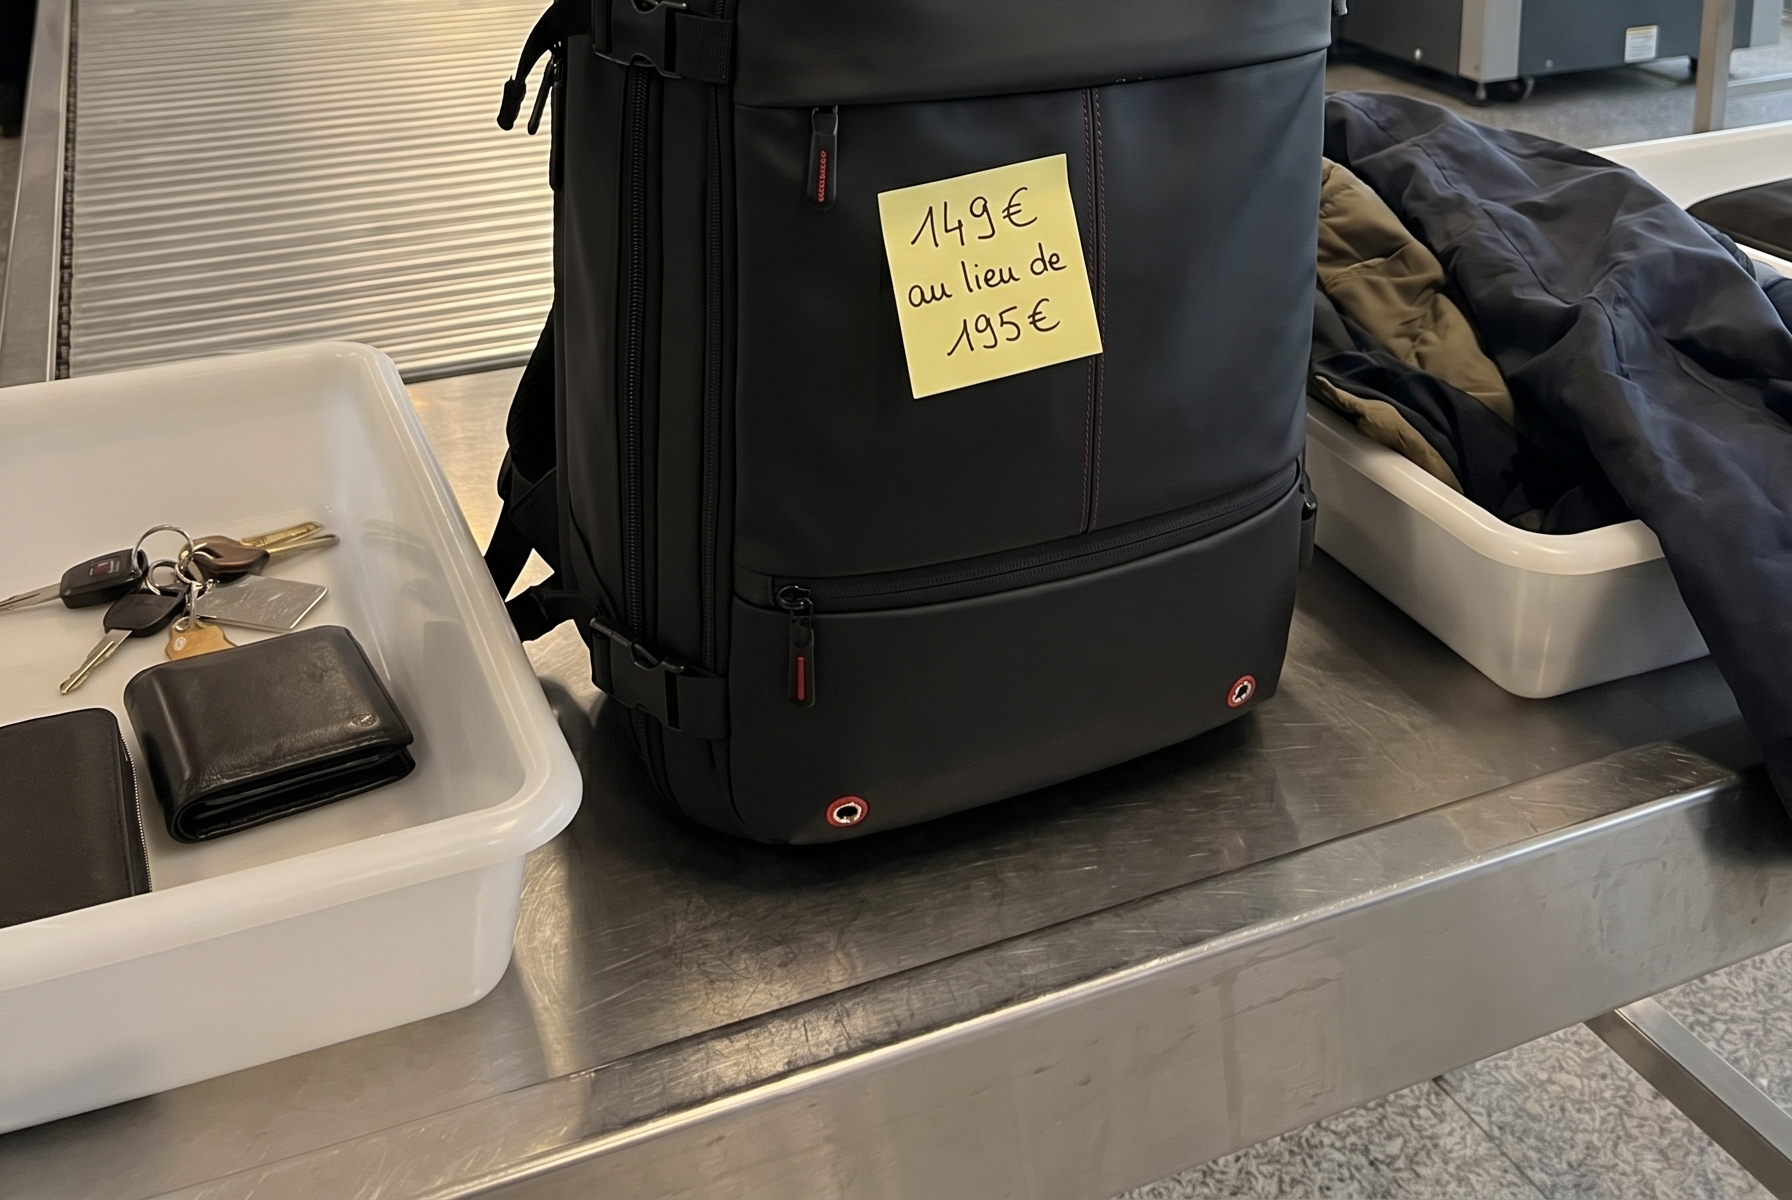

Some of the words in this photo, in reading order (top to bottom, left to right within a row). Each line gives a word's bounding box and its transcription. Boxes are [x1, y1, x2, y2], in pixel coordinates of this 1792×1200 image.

[910, 186, 1038, 248] 149€
[908, 283, 953, 308] au
[961, 260, 1021, 293] lieu
[1030, 242, 1067, 276] de
[946, 297, 1061, 357] 195€
